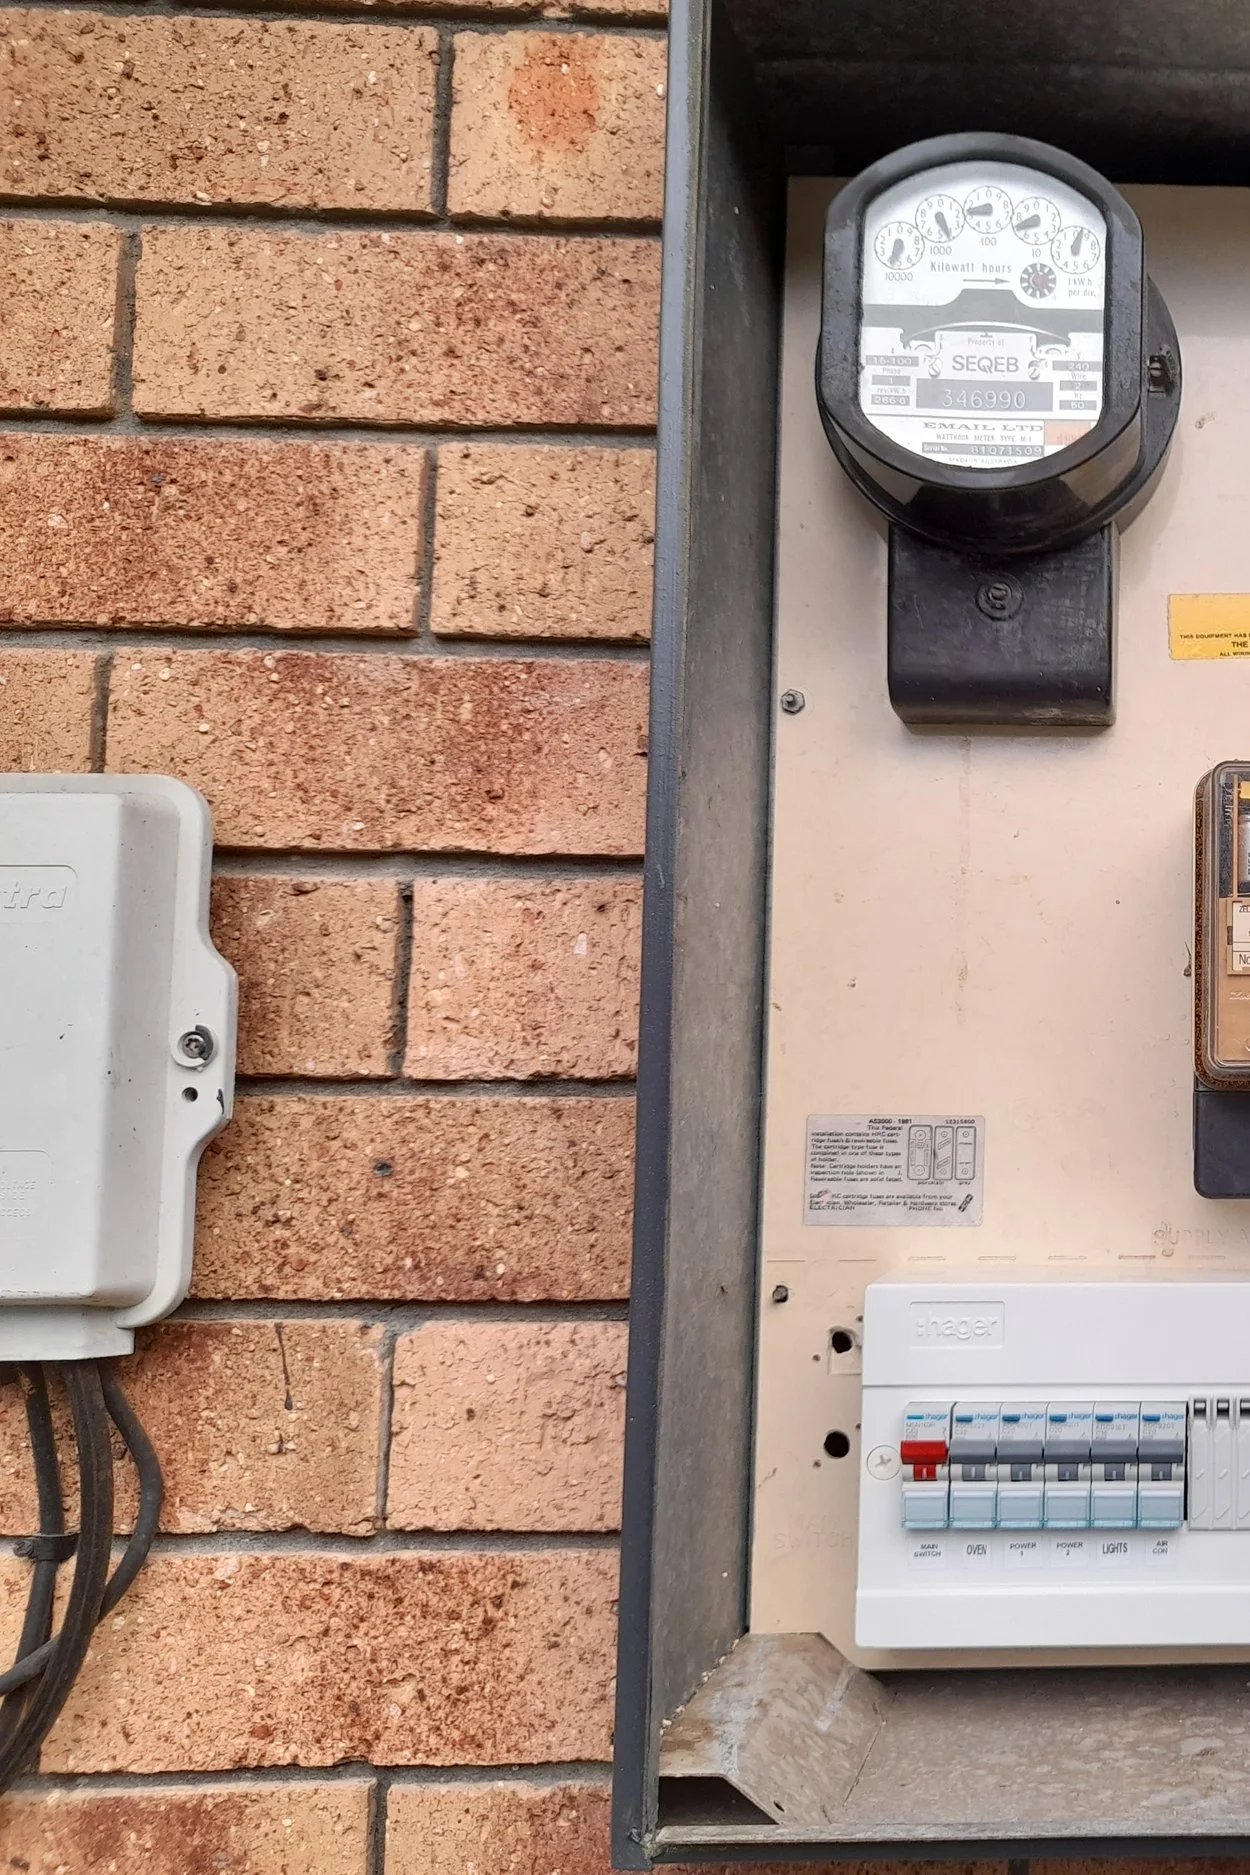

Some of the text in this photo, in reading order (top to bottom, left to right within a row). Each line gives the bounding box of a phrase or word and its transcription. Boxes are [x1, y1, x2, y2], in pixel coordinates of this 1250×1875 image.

[980, 237, 997, 247] 100
[929, 246, 953, 256] 1000
[1031, 249, 1042, 258] 10
[930, 262, 1013, 274] Kilowatt hours
[885, 271, 914, 283] 10000
[952, 355, 1019, 374] SEQEB
[942, 388, 1027, 409] 346990
[923, 422, 995, 431] EMAIL
[936, 433, 969, 441] WATTHOUR
[974, 434, 994, 442] METER
[1195, 632, 1233, 640] EQUIPMENT
[1231, 641, 1249, 649] THE
[0, 880, 68, 911] tra
[926, 1311, 1000, 1341] hager
[927, 1411, 949, 1421] hager
[976, 1411, 999, 1421] hager
[1023, 1411, 1045, 1421] hager
[1070, 1411, 1092, 1421] hager
[1117, 1411, 1138, 1421] hager
[1163, 1411, 1185, 1421] hager
[966, 1544, 988, 1556] OVEN
[1009, 1542, 1037, 1550] POWER
[1056, 1541, 1083, 1549] POWER
[1102, 1542, 1128, 1555] LIGHTS
